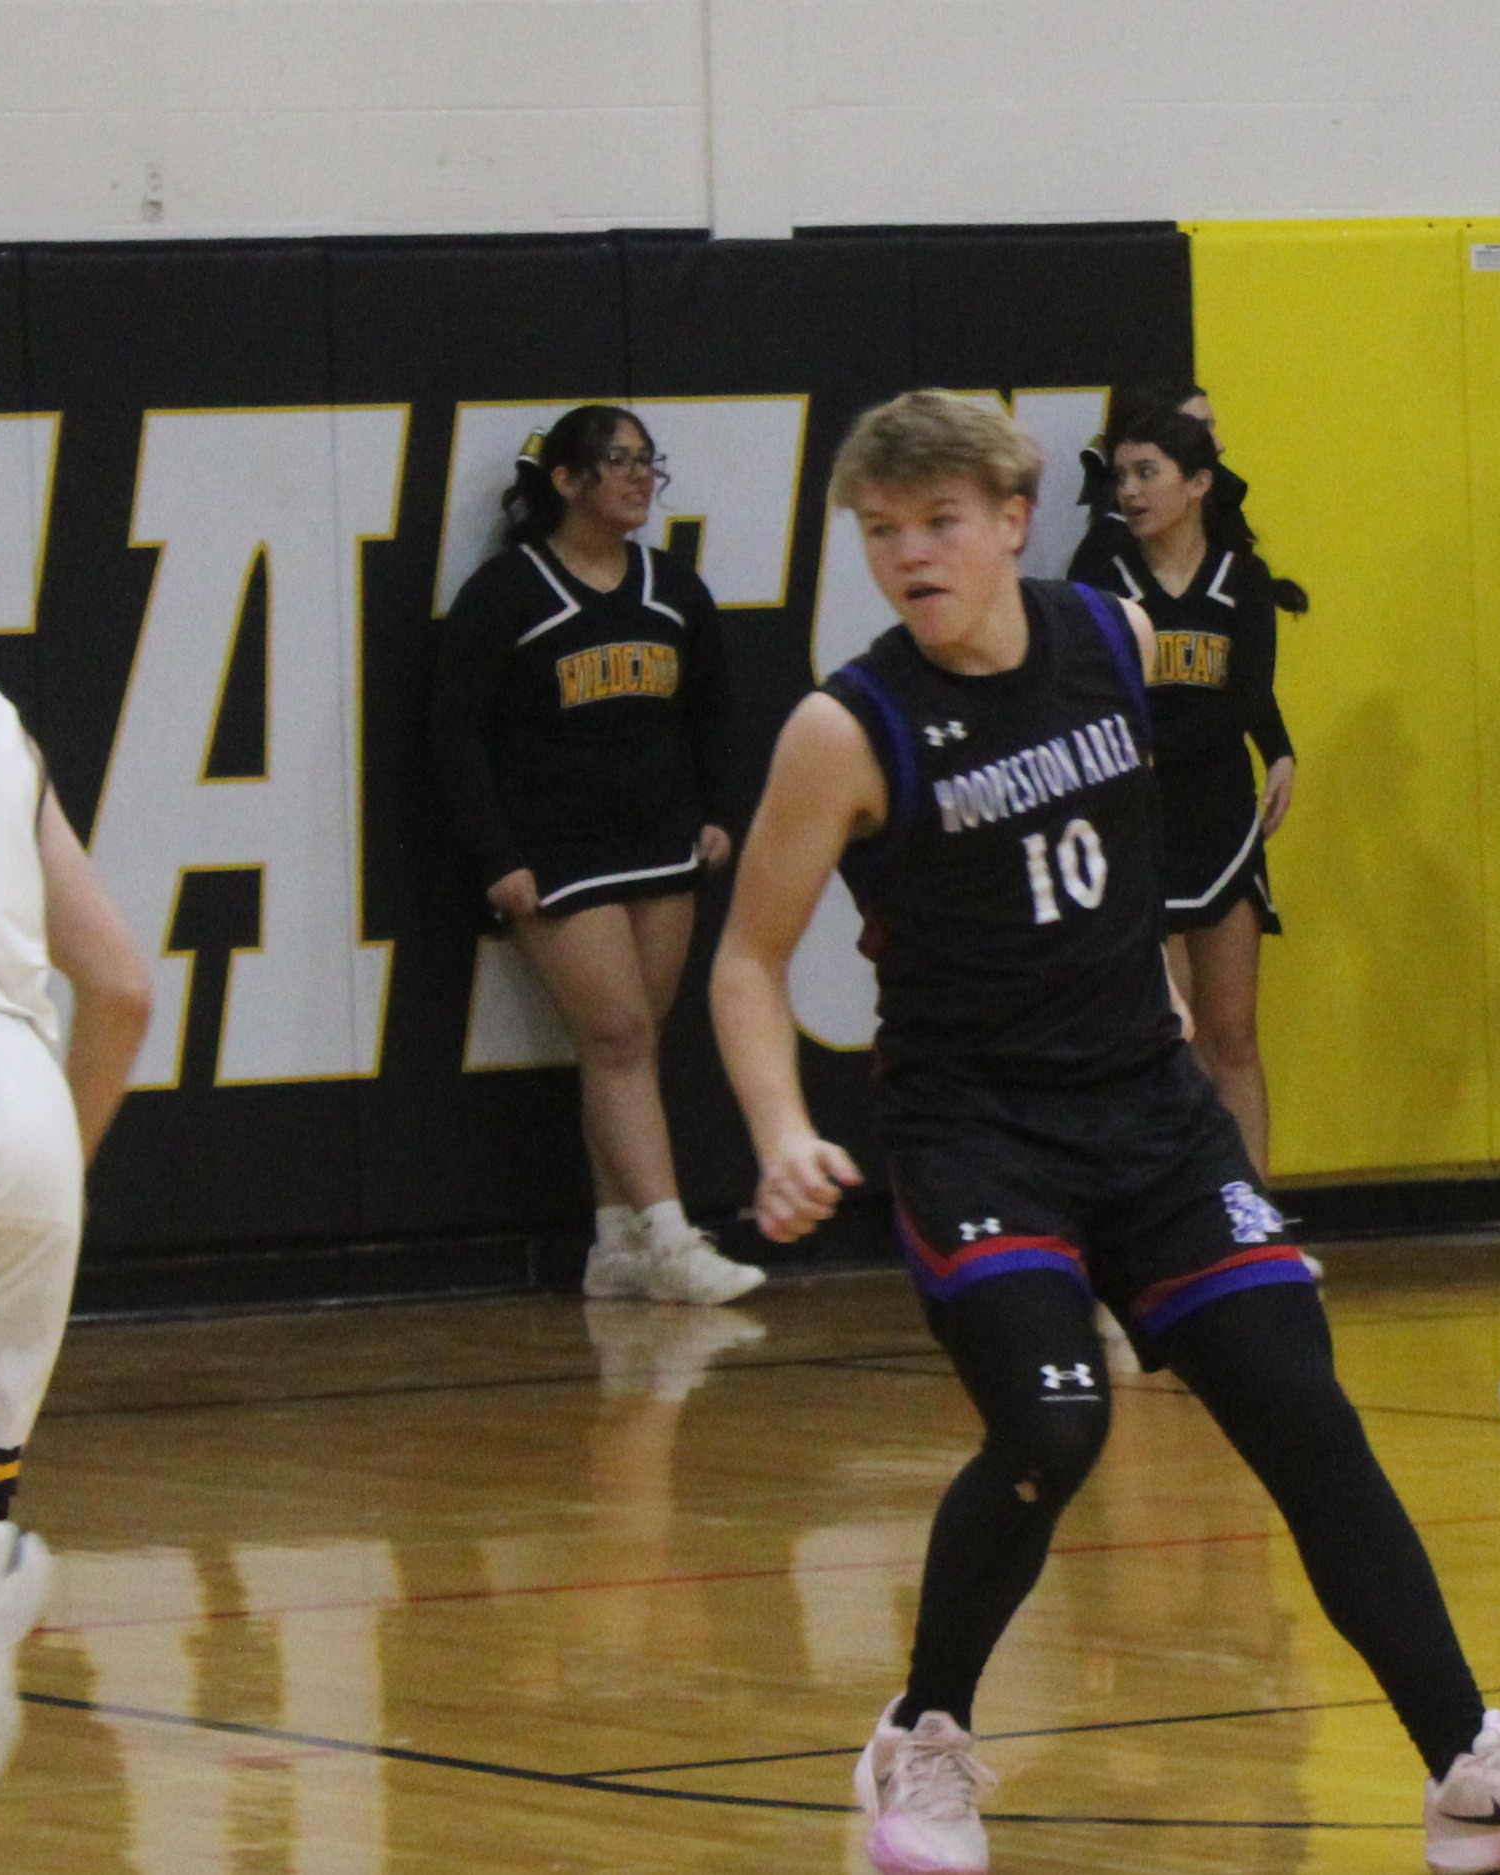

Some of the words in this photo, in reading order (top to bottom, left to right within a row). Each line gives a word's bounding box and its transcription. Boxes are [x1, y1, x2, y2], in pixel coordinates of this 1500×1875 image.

[556, 640, 678, 709] WILDCATS
[1144, 629, 1231, 688] DCAT
[933, 736, 1083, 834] HOOPESTON
[1071, 713, 1141, 786] AREA
[1020, 818, 1108, 925] 10
